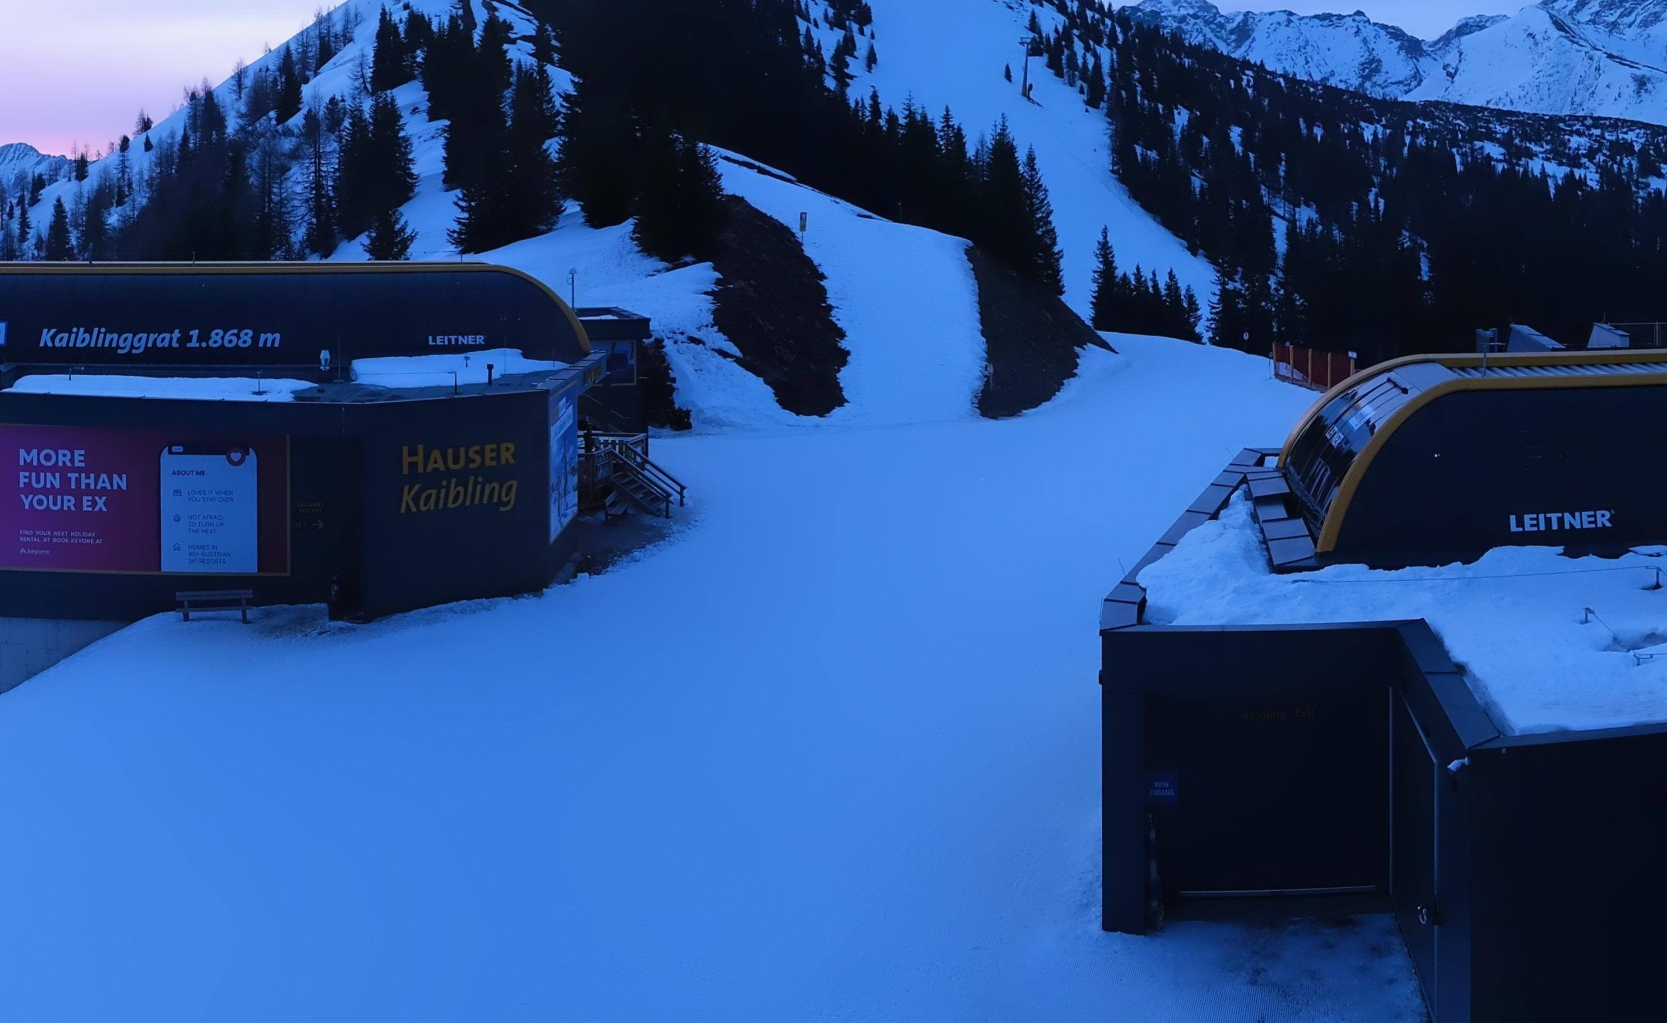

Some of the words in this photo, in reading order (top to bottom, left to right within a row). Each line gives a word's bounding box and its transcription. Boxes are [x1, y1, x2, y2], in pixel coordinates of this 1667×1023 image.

[39, 327, 181, 355] Kaiblinggrat
[186, 328, 253, 349] 1.868
[258, 332, 280, 348] m
[428, 335, 486, 346] LEITNER
[19, 448, 86, 467] MORE
[402, 442, 516, 475] HAUSER
[19, 471, 61, 489] FUN
[67, 472, 128, 491] THAN
[19, 494, 76, 511] YOUR
[82, 495, 108, 512] EX
[400, 476, 518, 514] Kaibling
[1509, 510, 1613, 533] LEITNER
[1241, 708, 1287, 722] Ausgang
[1295, 708, 1315, 721] Exit
